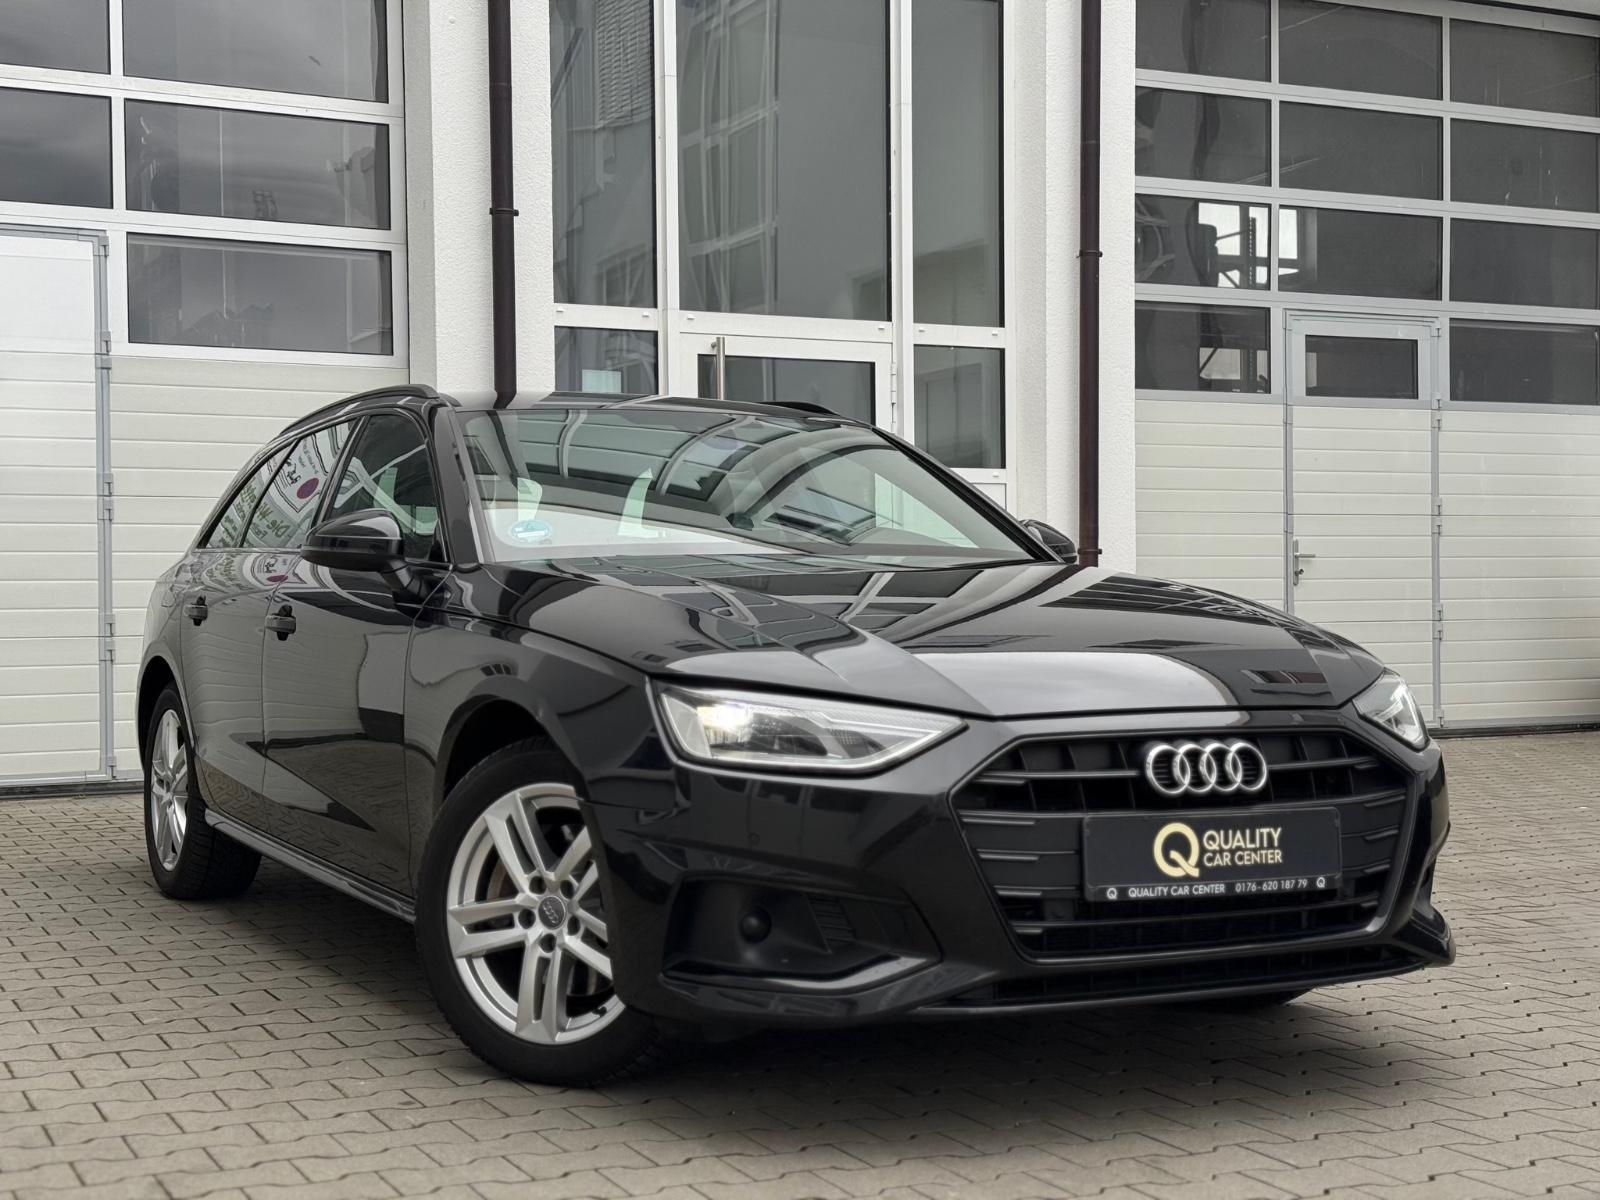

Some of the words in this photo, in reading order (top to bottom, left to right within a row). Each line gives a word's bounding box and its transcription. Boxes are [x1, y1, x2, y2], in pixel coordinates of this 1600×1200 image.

[1203, 827, 1282, 850] QUALITY
[1154, 822, 1199, 877] Q
[1203, 851, 1232, 867] CAR
[1234, 849, 1282, 865] CENTER
[1128, 886, 1169, 898] QUALITY
[1170, 885, 1190, 896] CAR
[1192, 884, 1226, 895] CENTER
[1280, 879, 1295, 890] 187
[1297, 878, 1308, 888] 79
